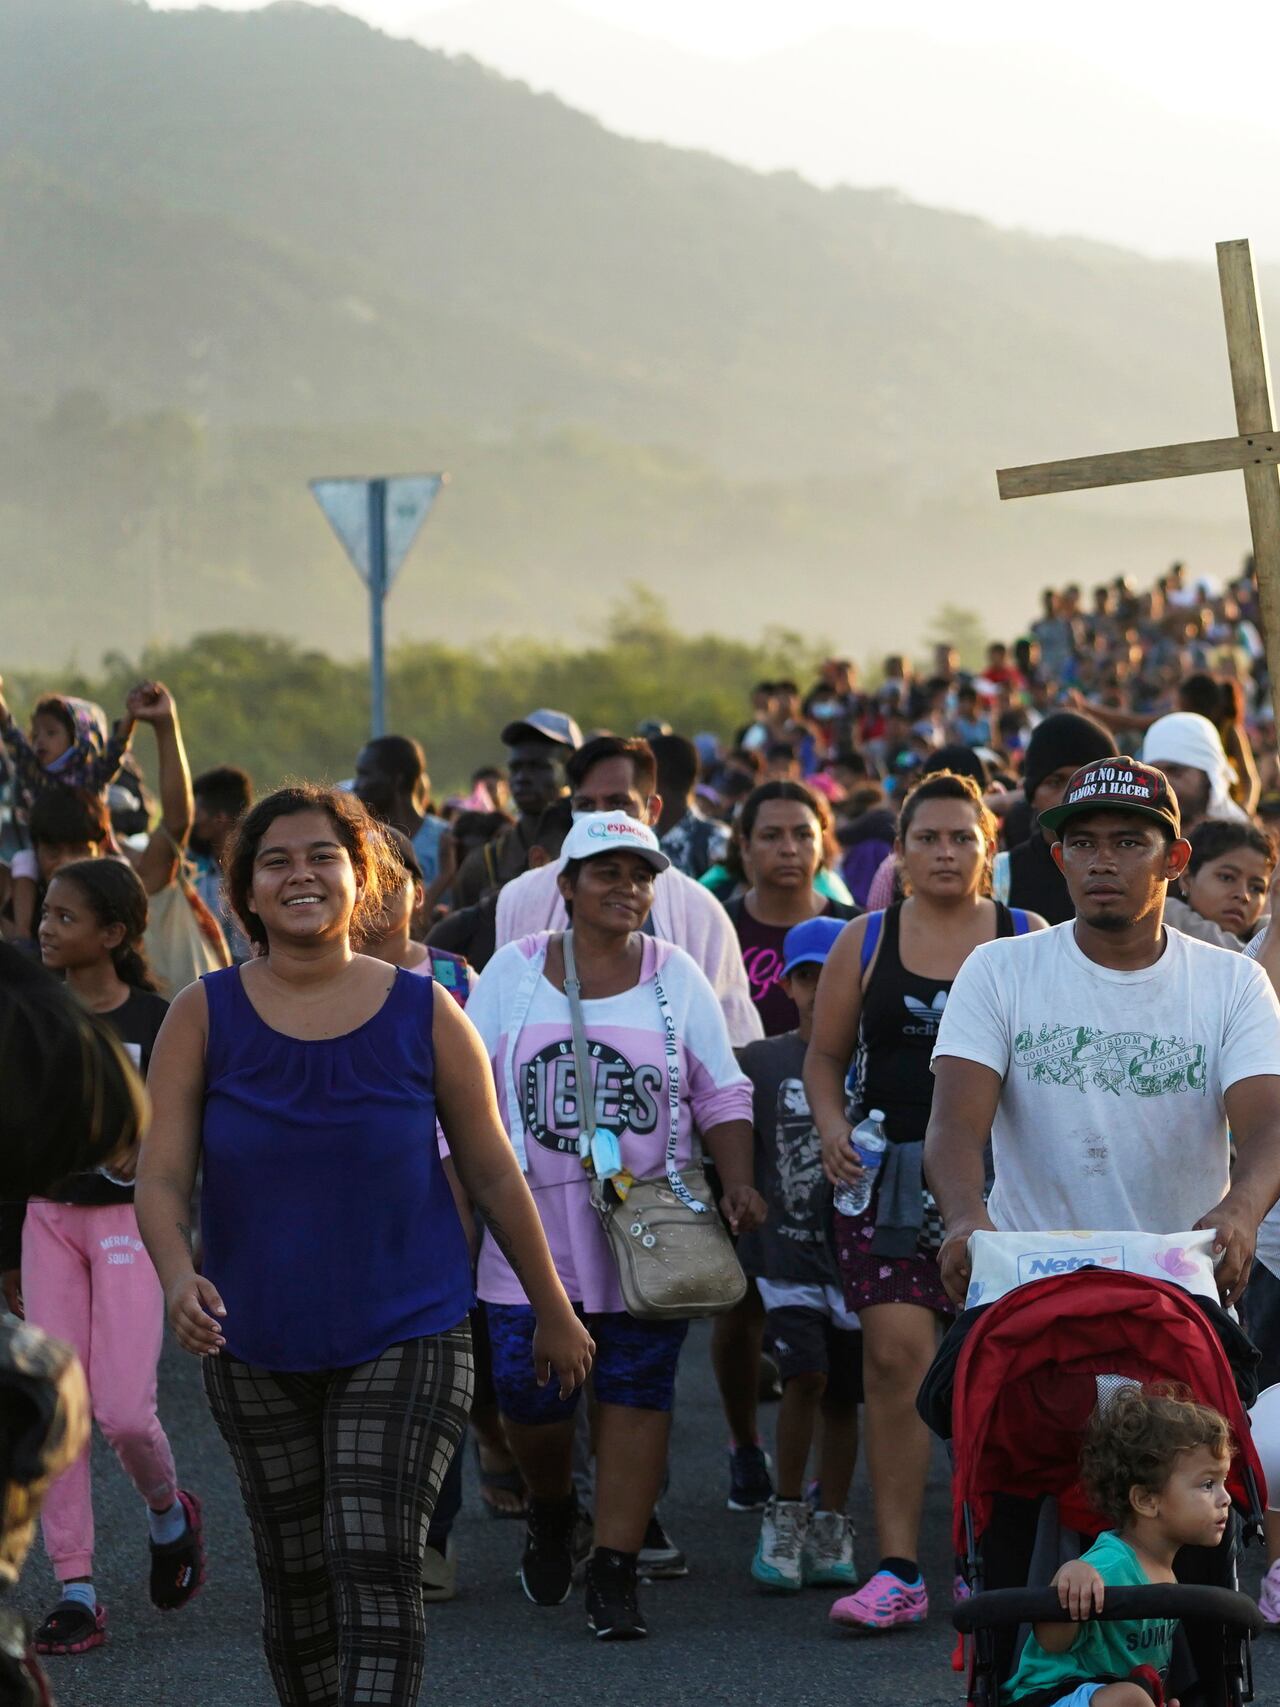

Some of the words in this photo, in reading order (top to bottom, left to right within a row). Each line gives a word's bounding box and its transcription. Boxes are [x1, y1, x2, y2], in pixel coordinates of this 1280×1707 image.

[1097, 767, 1115, 781] NO
[1117, 770, 1133, 783] LO
[1098, 782, 1107, 794] A
[1109, 782, 1150, 798] HACER
[902, 1023, 938, 1036] adi
[558, 1042, 602, 1058] GD
[1023, 1036, 1074, 1062] COURAGE
[1093, 1035, 1142, 1053] WISDOM
[1152, 1052, 1192, 1073] POWER
[668, 1065, 680, 1109] VIBES
[666, 1119, 679, 1161] VIBES
[1028, 1256, 1096, 1275] Neto
